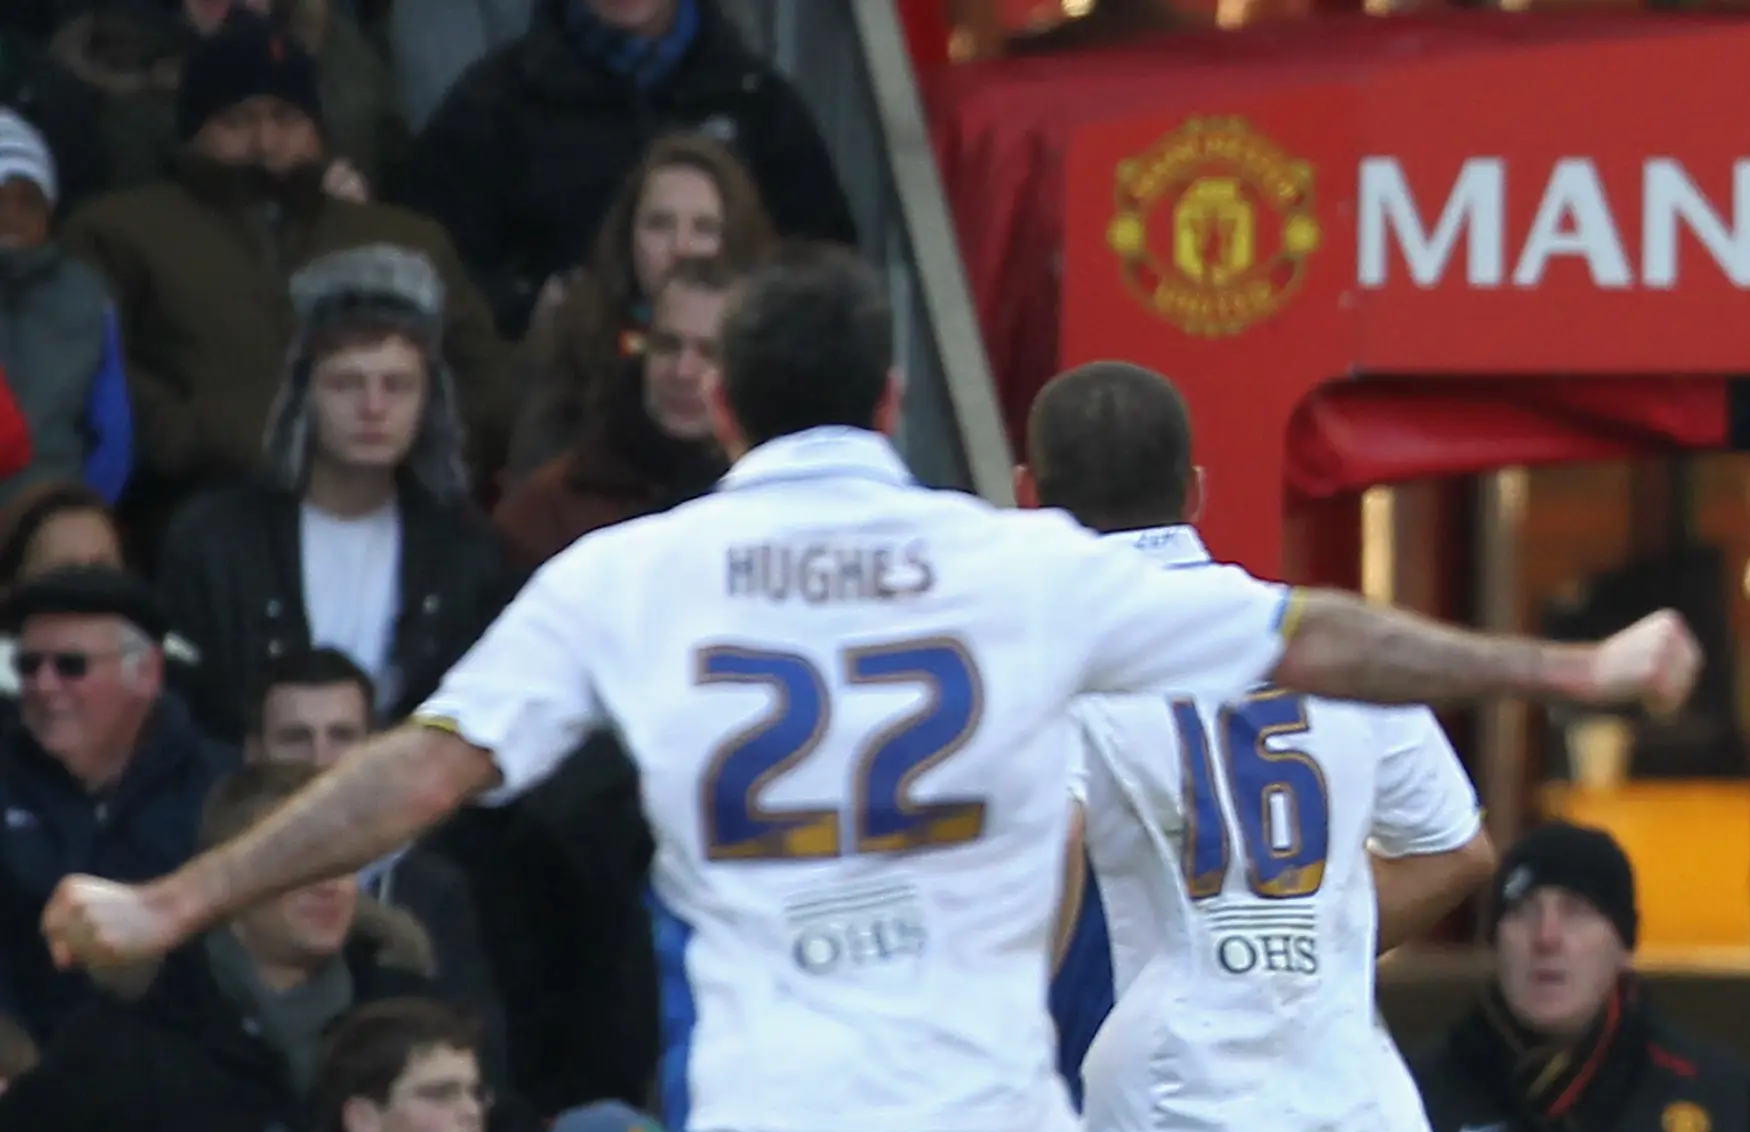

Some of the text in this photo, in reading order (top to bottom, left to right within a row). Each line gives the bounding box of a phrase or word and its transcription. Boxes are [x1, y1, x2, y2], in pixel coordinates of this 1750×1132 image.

[726, 542, 936, 604] HUGHES
[694, 633, 990, 860] 22
[1172, 688, 1331, 900] 16
[1217, 934, 1320, 976] OHS
